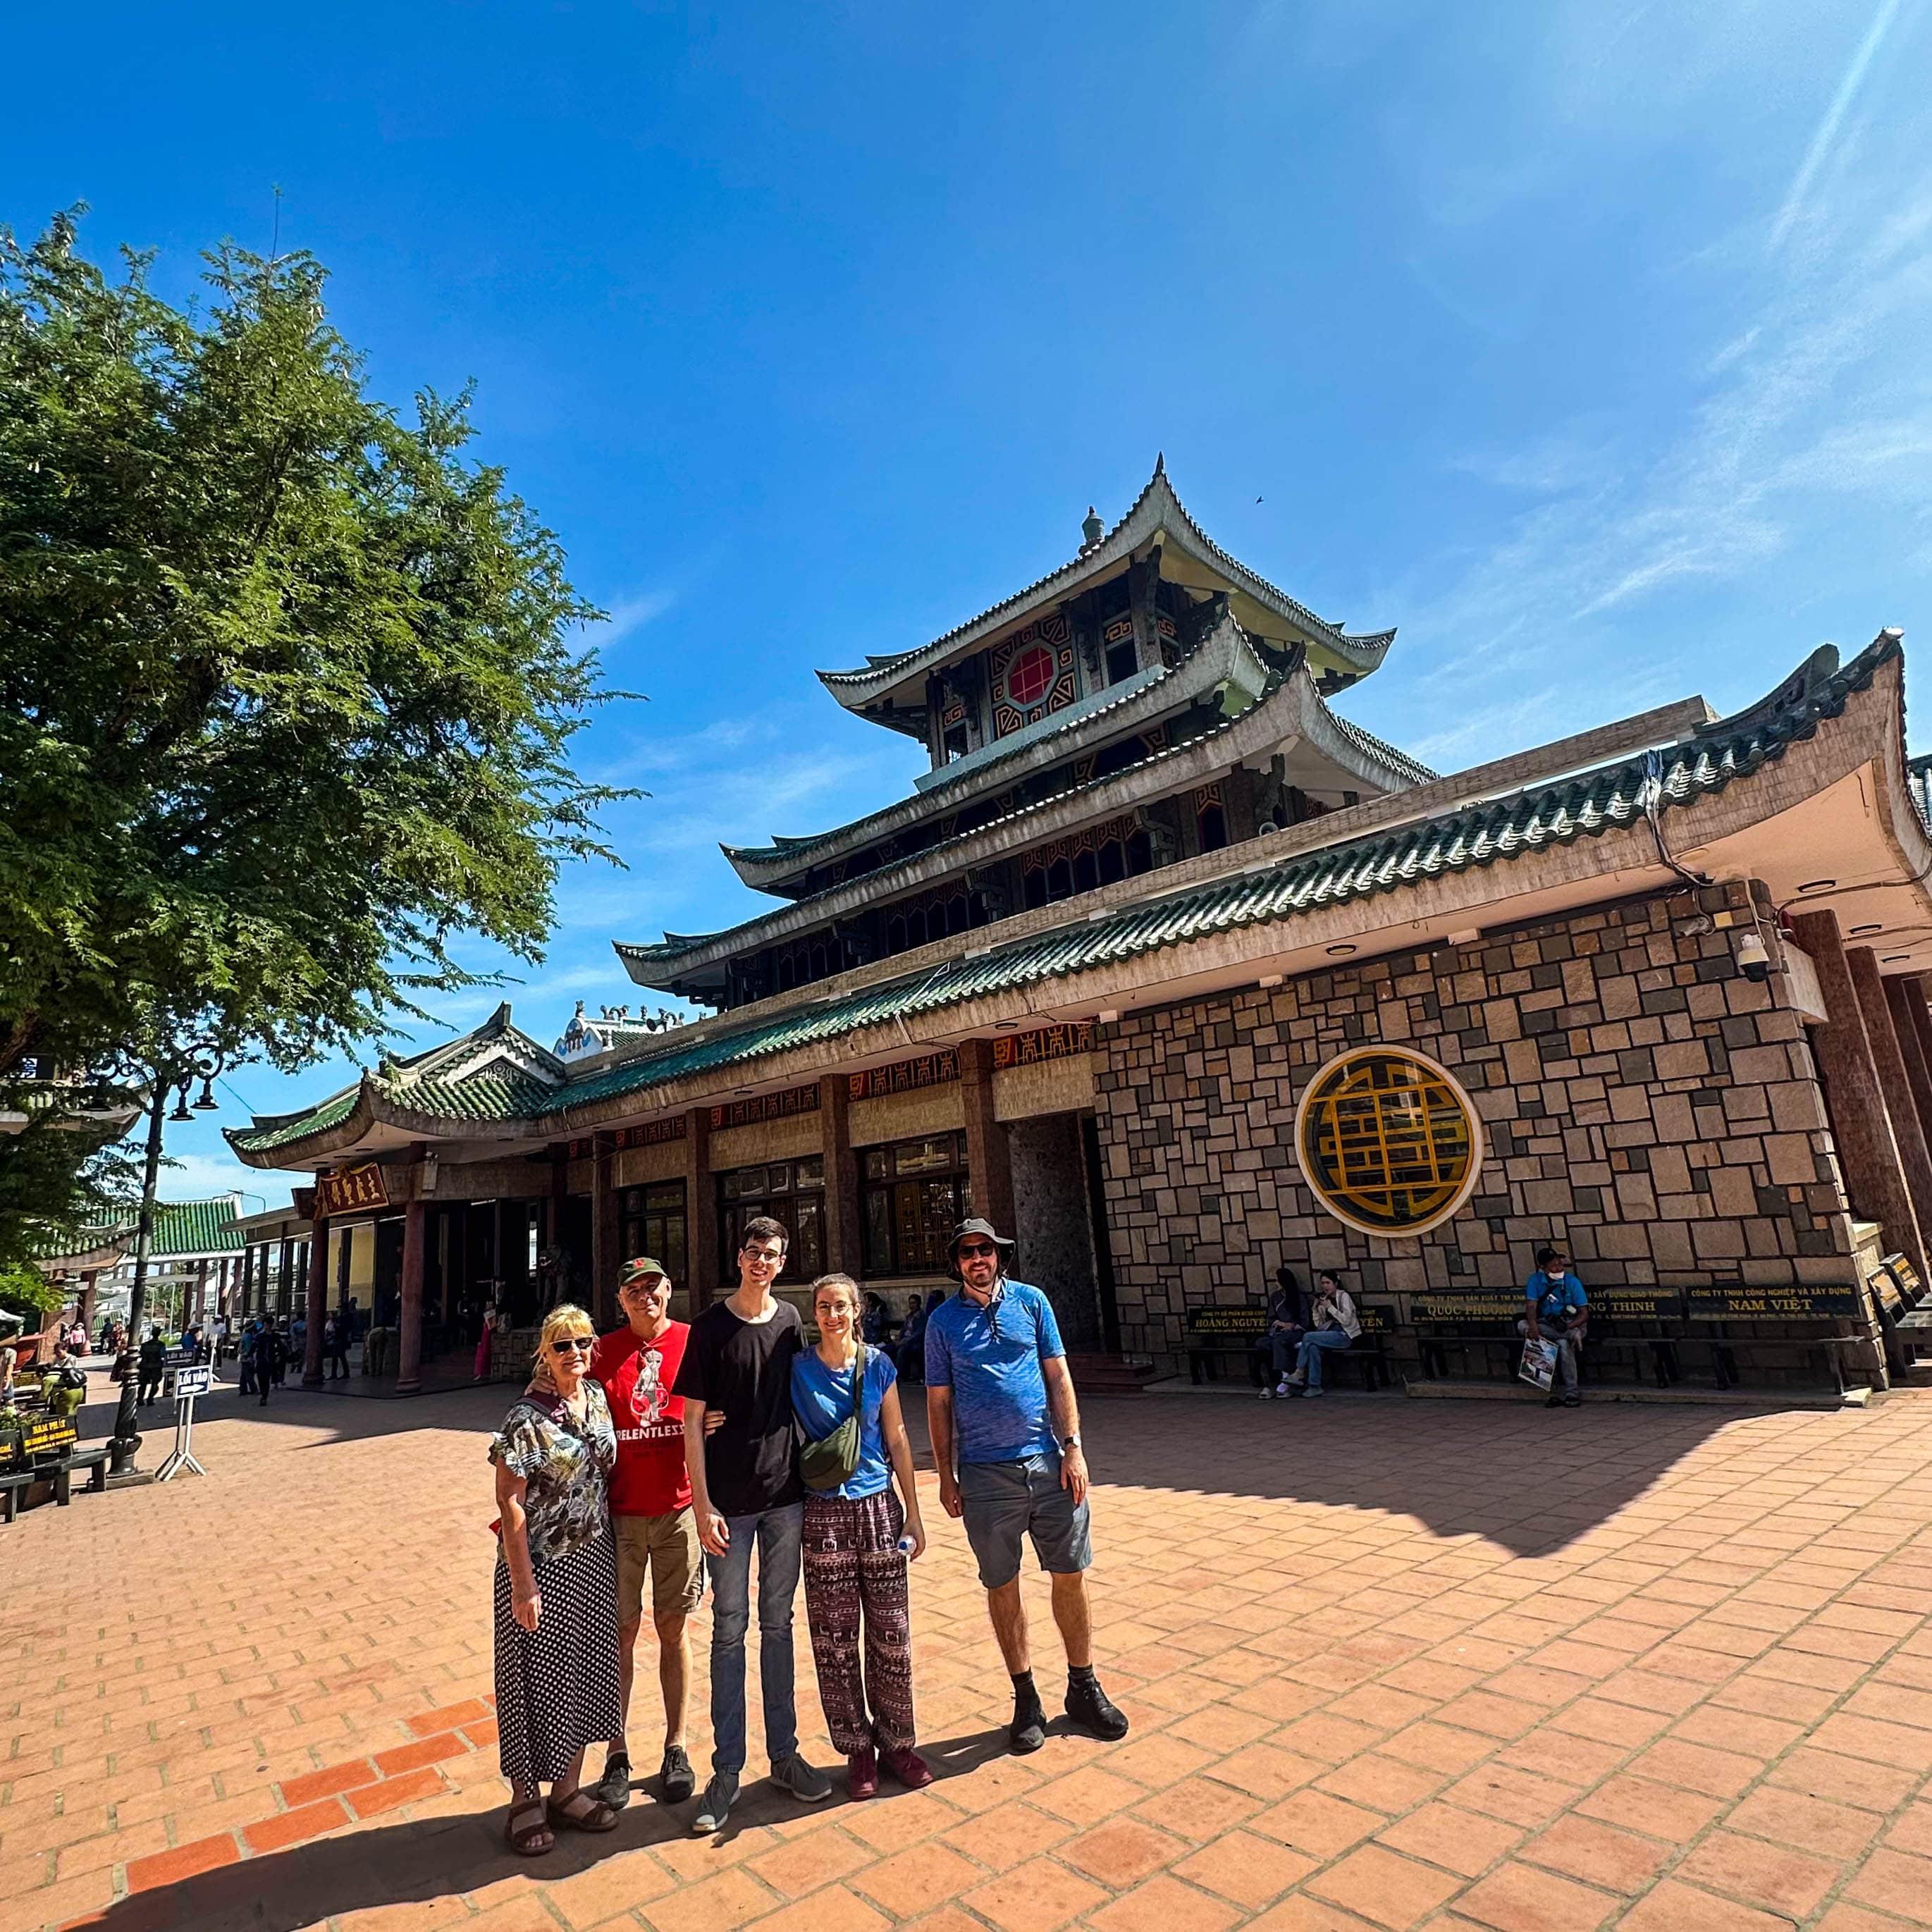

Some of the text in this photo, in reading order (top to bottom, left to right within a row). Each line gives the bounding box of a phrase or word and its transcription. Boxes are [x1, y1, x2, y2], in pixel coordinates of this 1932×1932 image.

[1727, 1297, 1813, 1312] NAM VIỆT
[179, 1370, 208, 1385] LỐI VÀO
[615, 1424, 685, 1441] RELENTLESS
